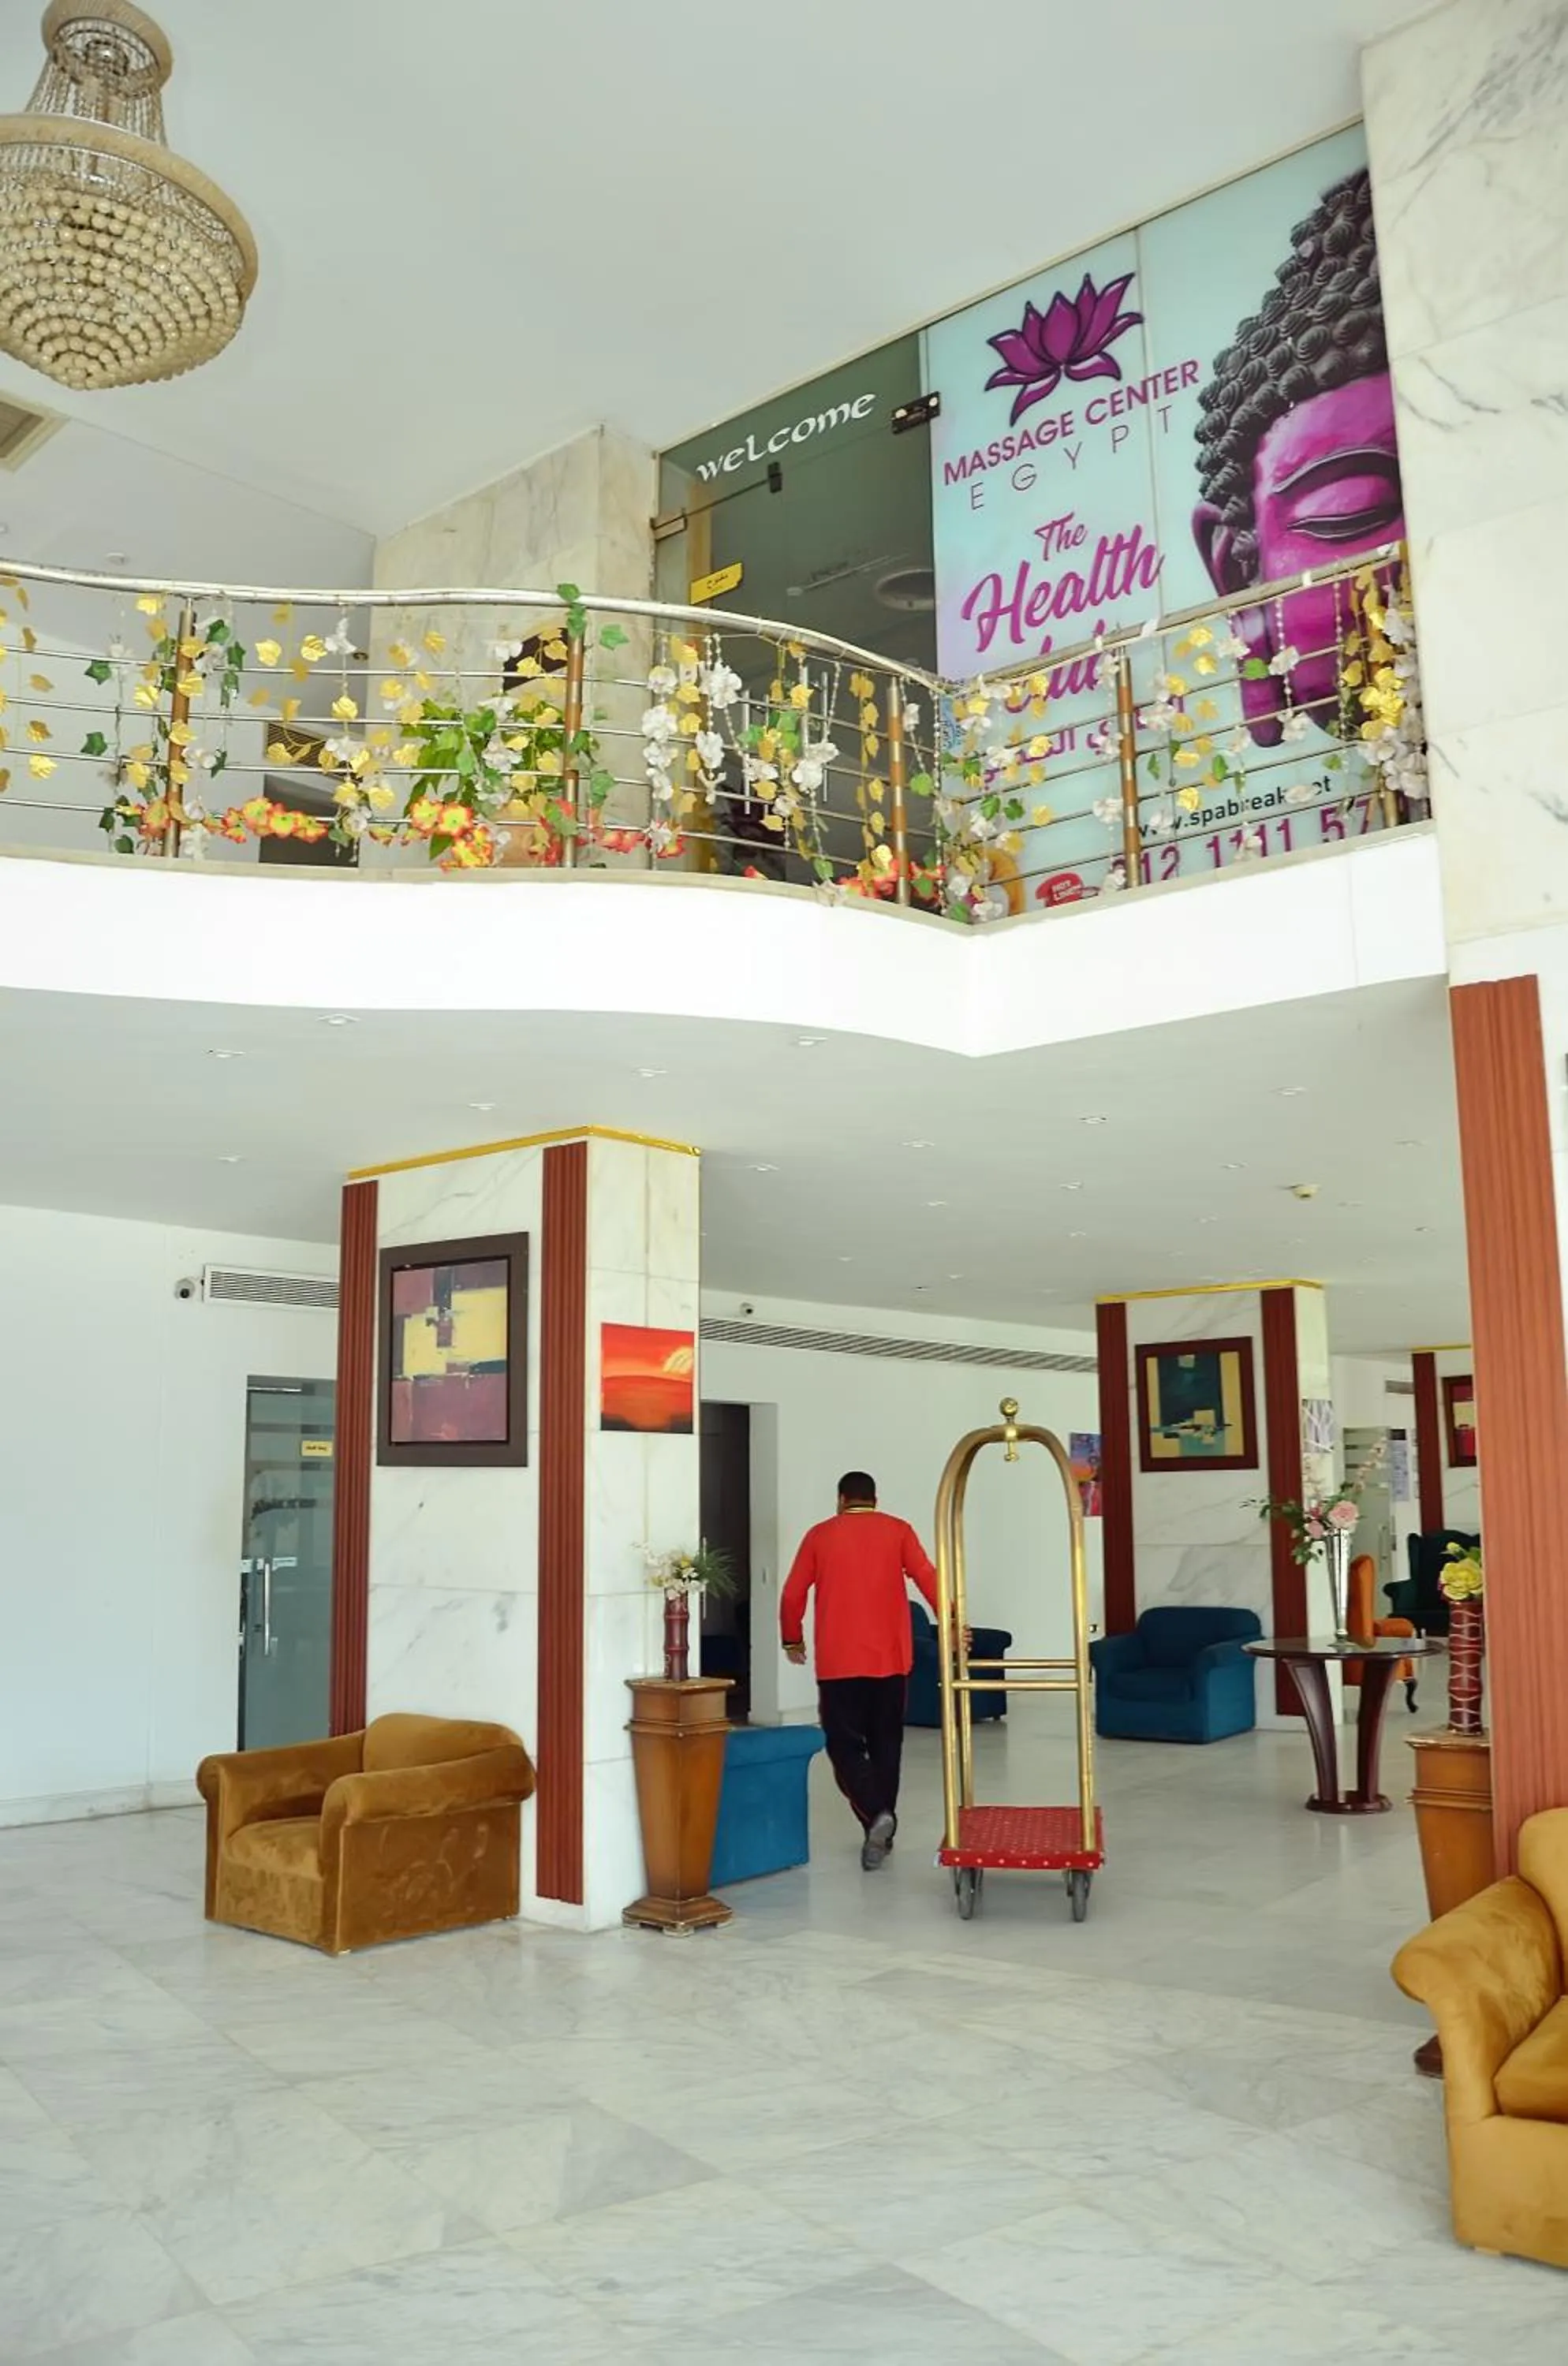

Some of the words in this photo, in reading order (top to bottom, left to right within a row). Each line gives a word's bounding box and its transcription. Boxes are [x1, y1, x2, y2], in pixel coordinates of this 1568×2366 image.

[696, 394, 875, 481] welcome
[943, 410, 1074, 486] MASSAGE
[1085, 360, 1200, 425] CENTER
[970, 405, 1173, 510] EGYPT
[1035, 513, 1088, 561] The
[961, 524, 1166, 653] Health
[1111, 844, 1182, 885] 12
